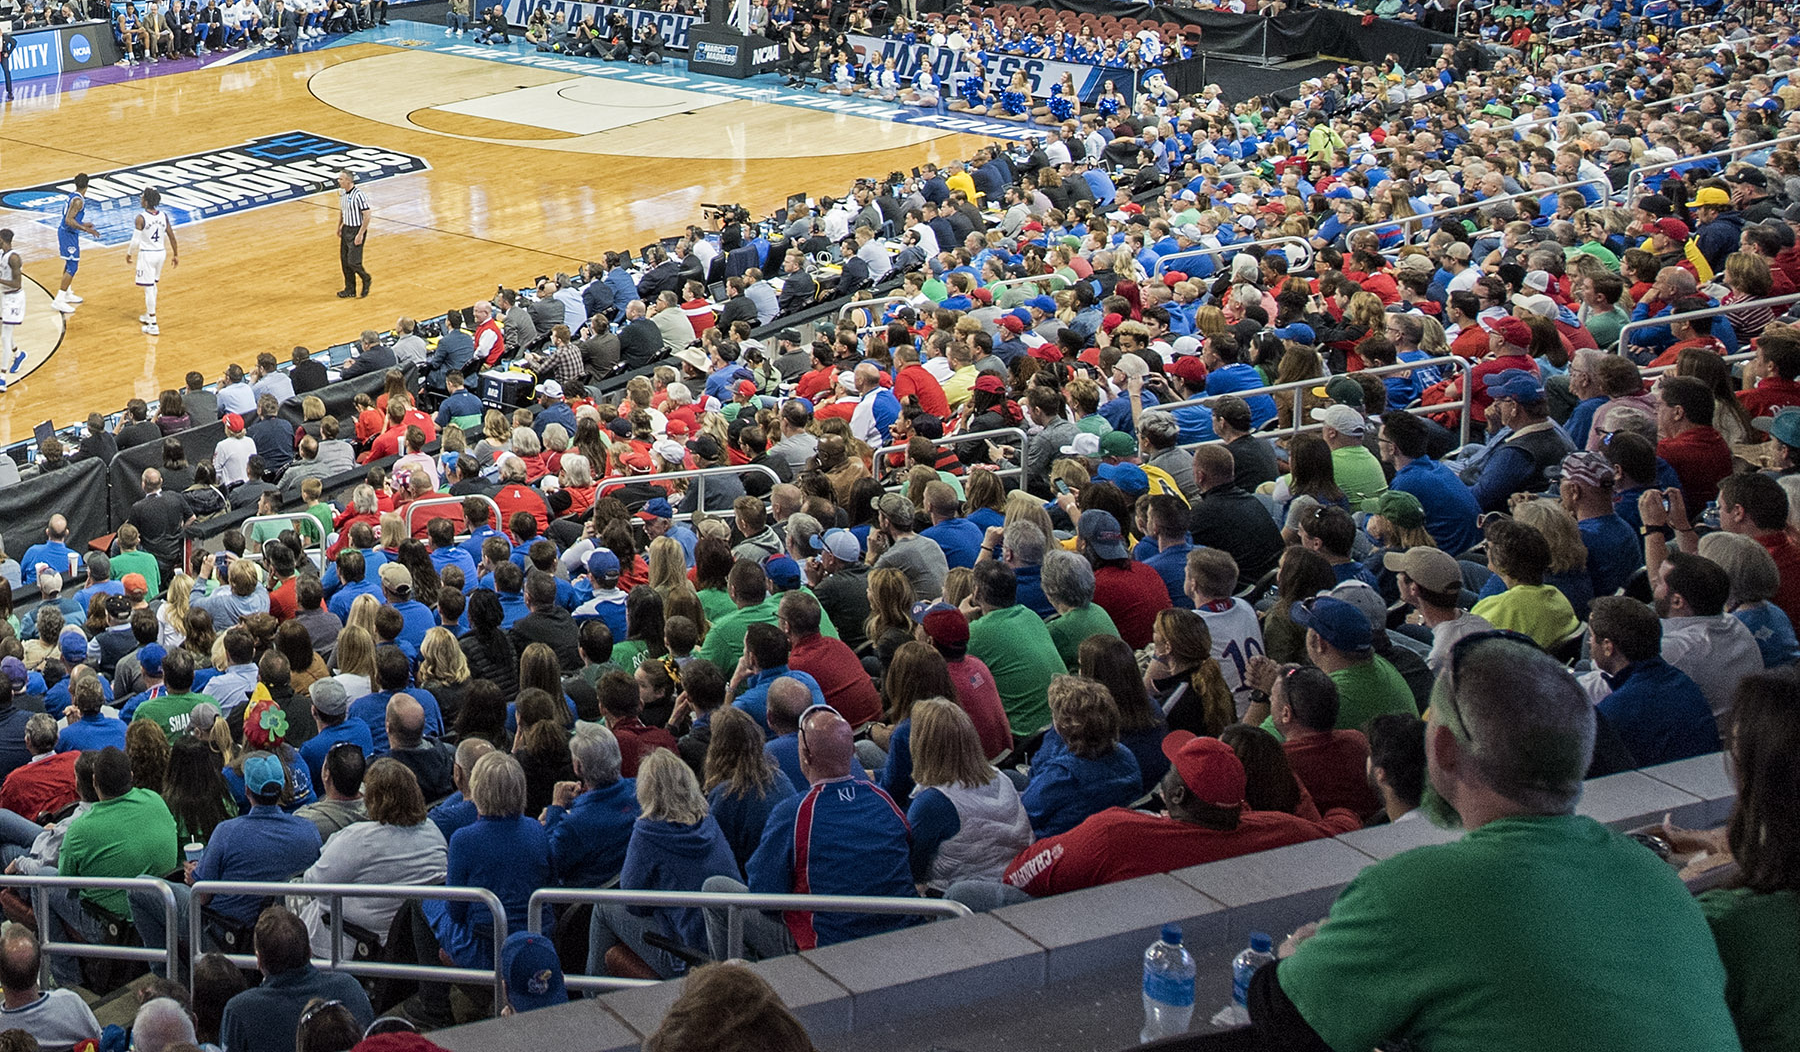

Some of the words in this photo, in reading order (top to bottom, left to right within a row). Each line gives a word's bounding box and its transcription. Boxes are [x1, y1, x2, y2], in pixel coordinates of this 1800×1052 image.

[73, 47, 91, 57] NCAA
[704, 44, 725, 53] MARCH
[752, 44, 780, 65] NCAA
[706, 52, 737, 65] MADNESS
[449, 44, 519, 60] THE
[516, 55, 629, 75] ROAD
[624, 70, 690, 86] TO
[689, 81, 783, 98] THE
[773, 94, 909, 118] FINAL
[81, 151, 263, 201] MARCH
[150, 228, 160, 243] 4
[1222, 637, 1264, 687] 10
[837, 786, 856, 801] KU
